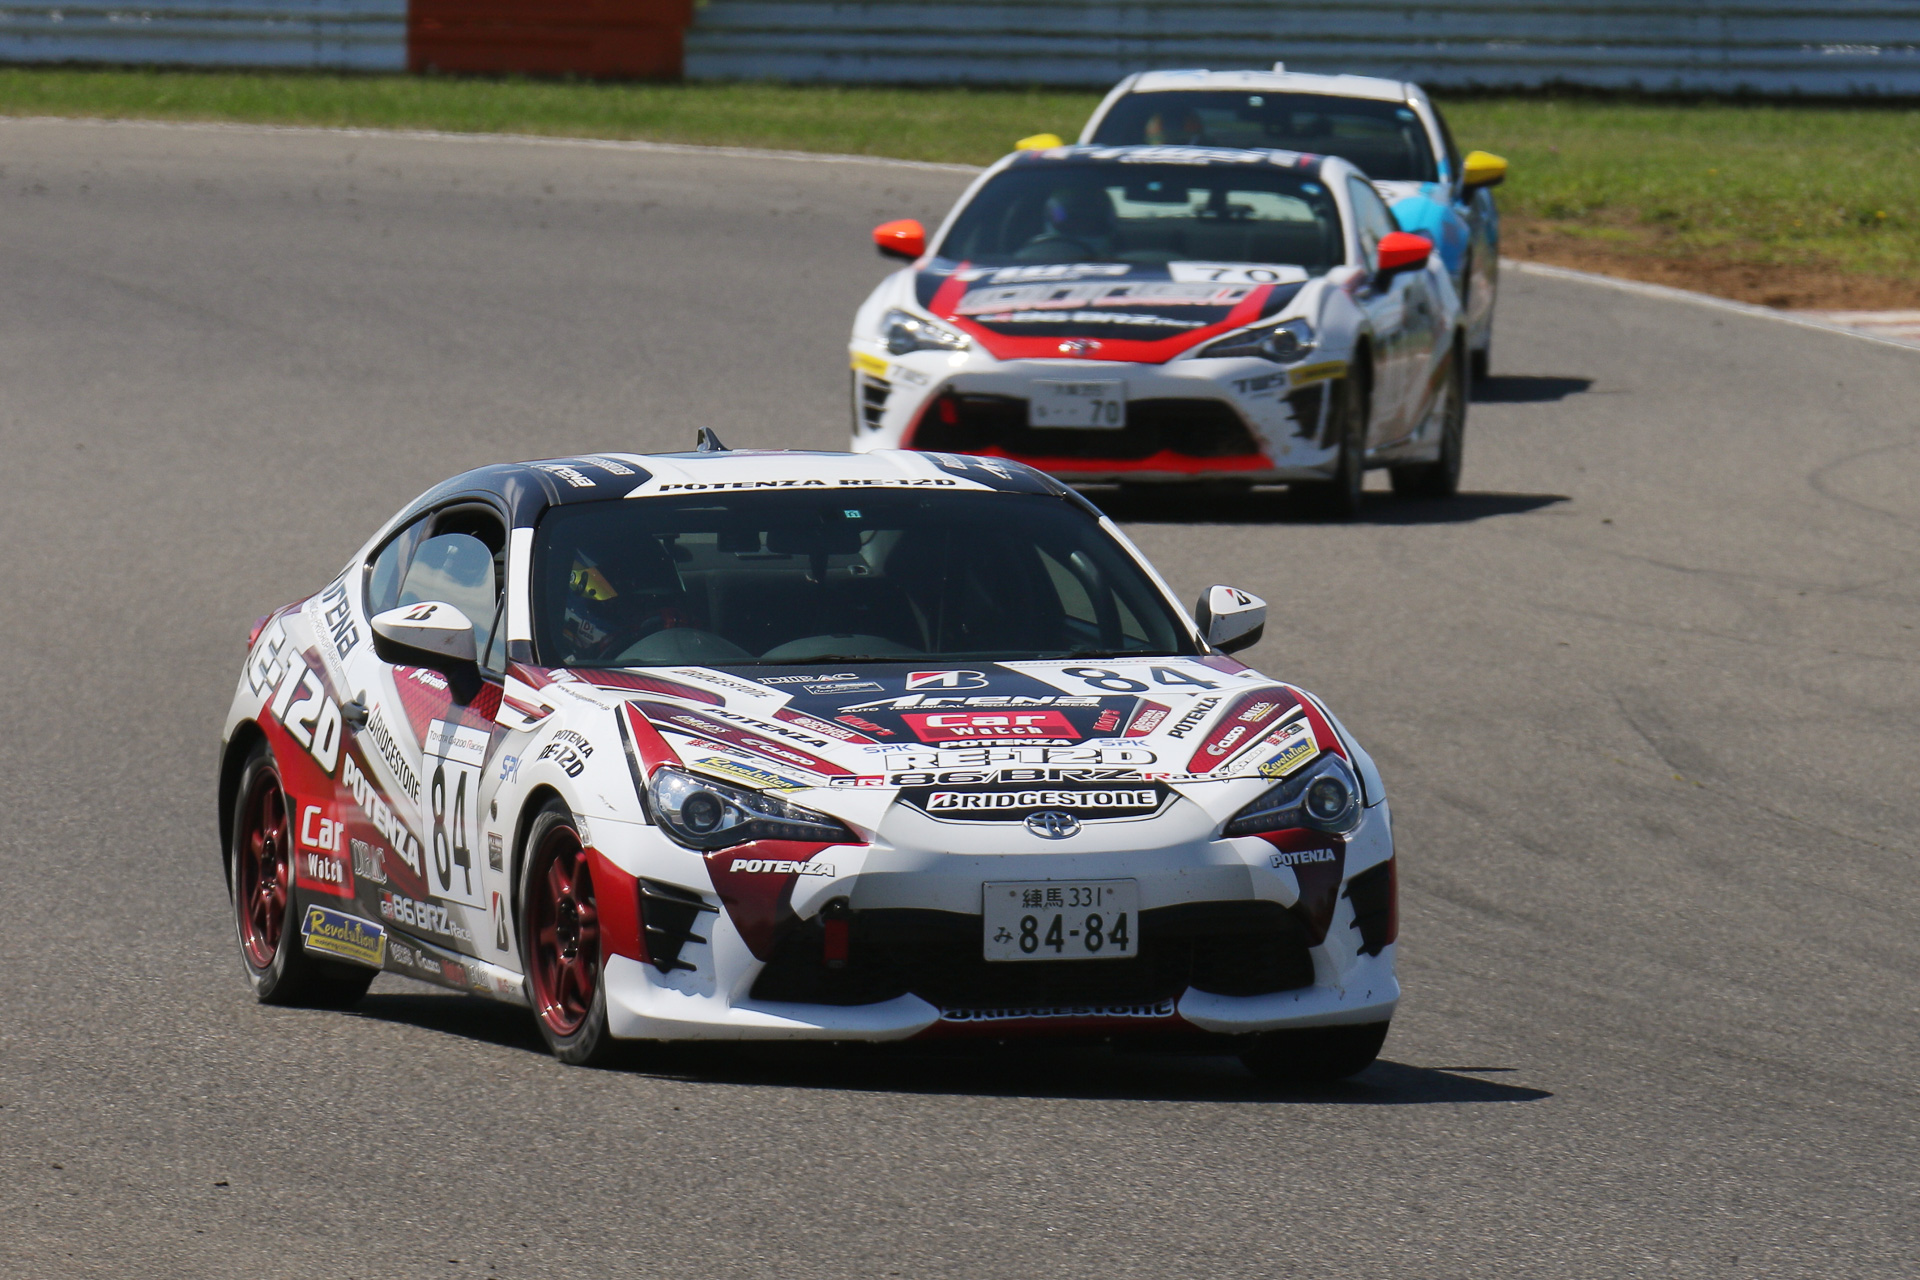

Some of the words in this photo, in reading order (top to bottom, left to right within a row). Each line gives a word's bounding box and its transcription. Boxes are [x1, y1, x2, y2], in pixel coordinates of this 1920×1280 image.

[1197, 268, 1278, 282] 70
[658, 480, 827, 491] POTENZA
[1061, 666, 1224, 692] 84
[701, 708, 829, 748] POTENZA
[925, 713, 1047, 728] Car
[1166, 696, 1223, 740] POTENZA
[939, 738, 1073, 749] POTENZA
[949, 727, 1045, 736] Watch
[1098, 740, 1151, 748] SPK
[367, 702, 420, 806] BRIDGESTONE
[552, 730, 595, 759] POTENZA
[862, 743, 911, 754] SPK
[537, 743, 585, 779] RE-12D
[885, 746, 1158, 771] RE-12D
[1259, 744, 1310, 776] Revolution
[703, 757, 796, 789] Revolution
[830, 776, 885, 787] GR
[889, 768, 1138, 785] 86/BRZ
[925, 790, 1158, 811] BRIDGESTONE
[342, 752, 421, 878] POTENZA
[301, 805, 345, 852] Car
[431, 764, 473, 895] 84
[307, 852, 343, 883] Watch
[730, 858, 836, 877] POTENZA
[1269, 848, 1336, 868] POTENZA
[1021, 887, 1064, 909] 練馬
[1068, 887, 1102, 908] 331
[310, 910, 379, 952] Revolution
[449, 919, 473, 943] Race
[992, 926, 1014, 945] み
[1019, 911, 1129, 953] 84-84
